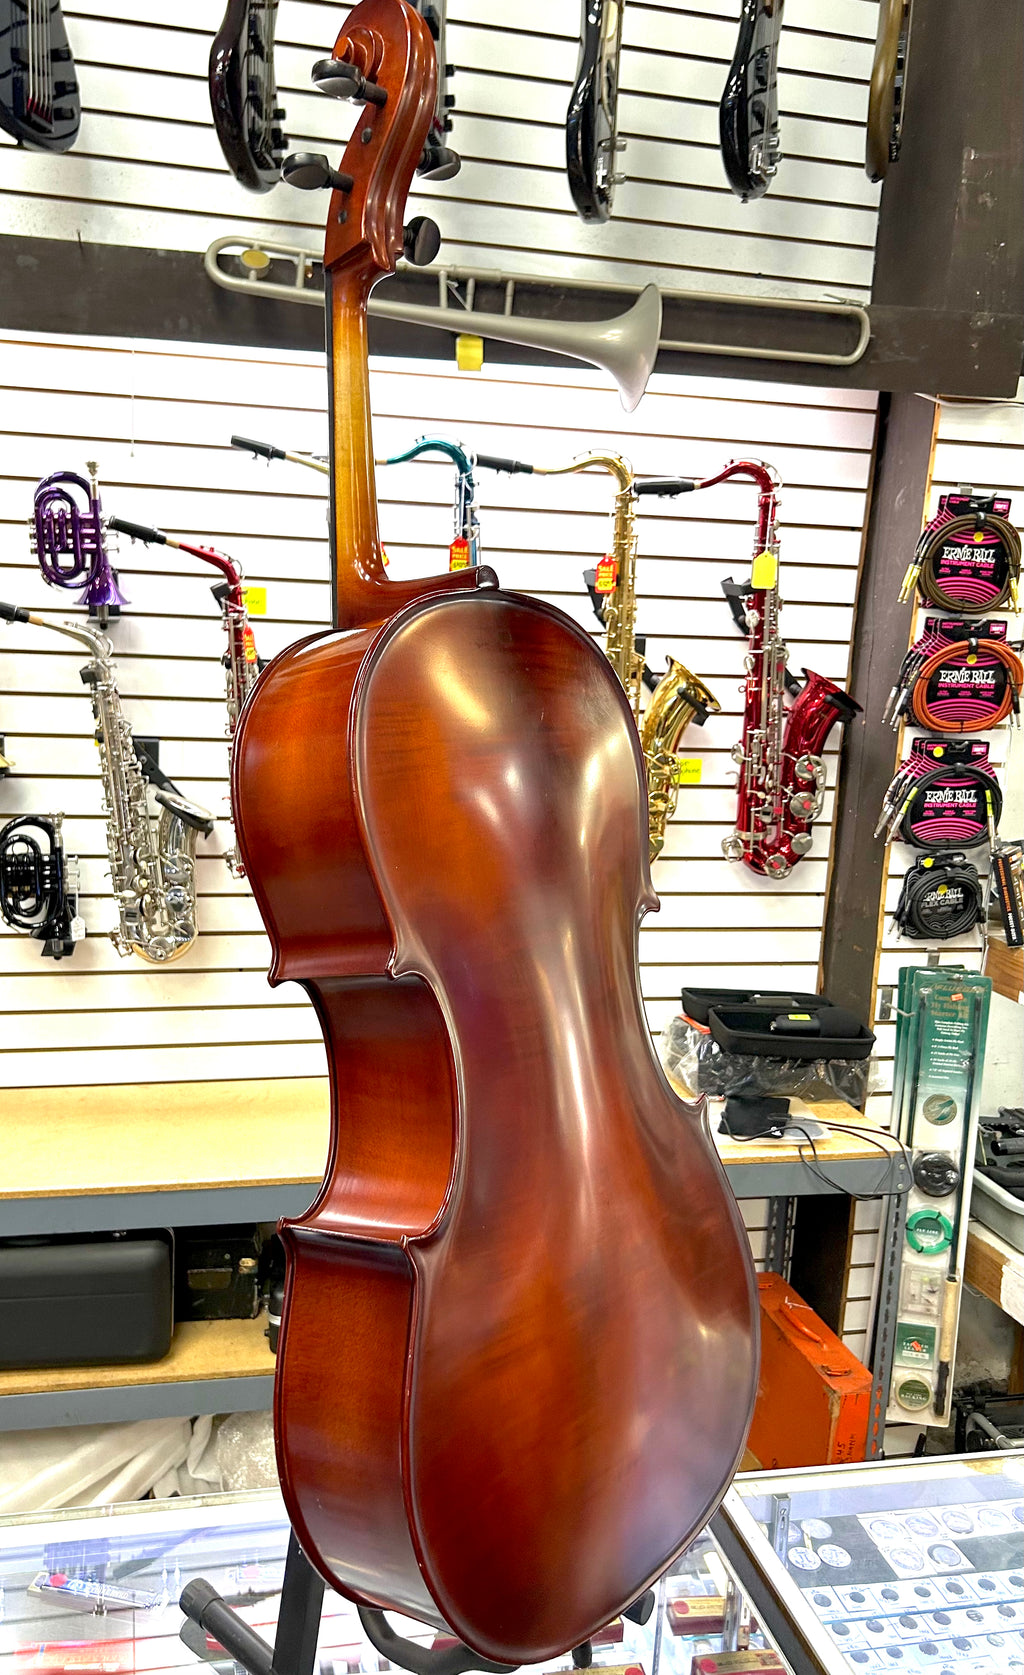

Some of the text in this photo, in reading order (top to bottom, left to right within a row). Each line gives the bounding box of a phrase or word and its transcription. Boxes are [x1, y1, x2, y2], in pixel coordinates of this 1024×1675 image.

[942, 544, 996, 564] ERNIE BALL
[940, 559, 976, 567] INSTRUMENT
[939, 667, 996, 684] ERNIE BALL
[925, 787, 977, 803] ERNIE BALL
[945, 887, 964, 899] BALL
[921, 897, 963, 908] FLEX CABLE
